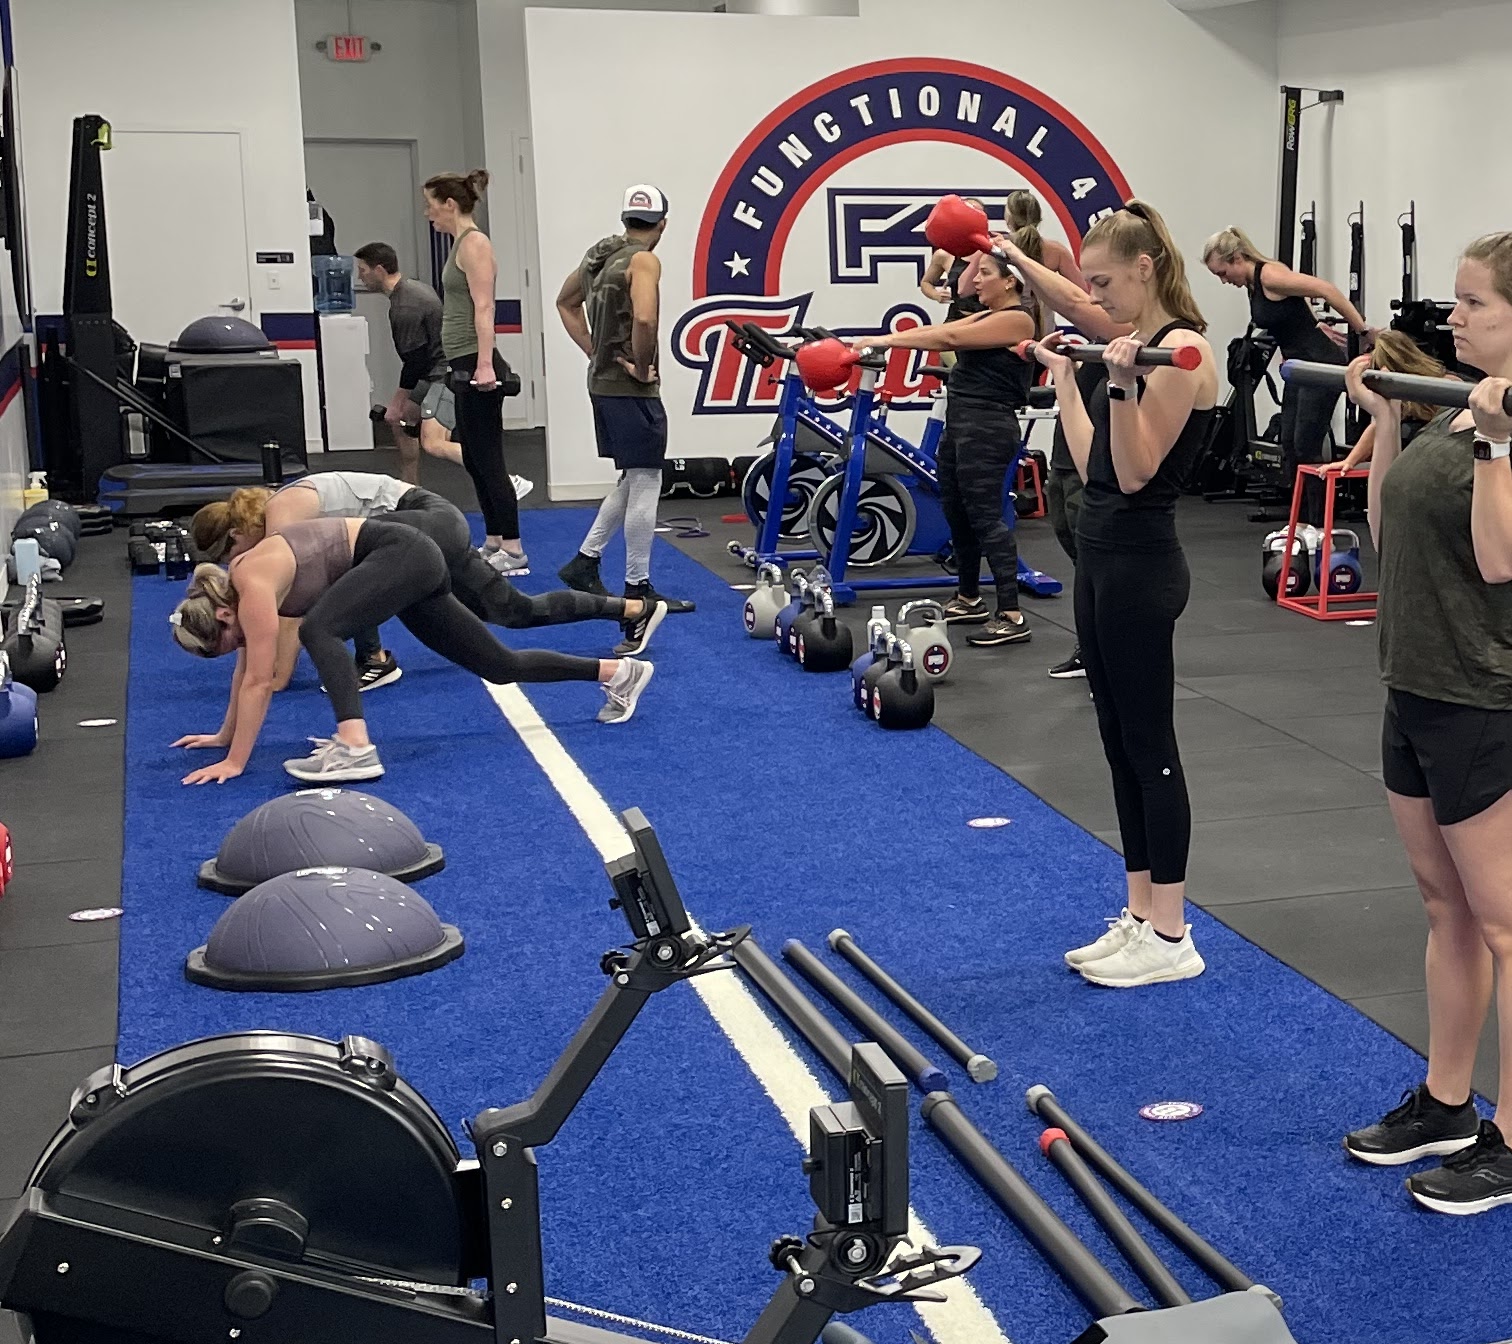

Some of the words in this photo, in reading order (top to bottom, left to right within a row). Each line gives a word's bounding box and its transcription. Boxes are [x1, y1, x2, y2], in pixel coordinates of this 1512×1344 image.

[334, 37, 364, 60] EXIT
[733, 84, 1051, 230] FUNCTIONAL
[86, 193, 97, 202] 2
